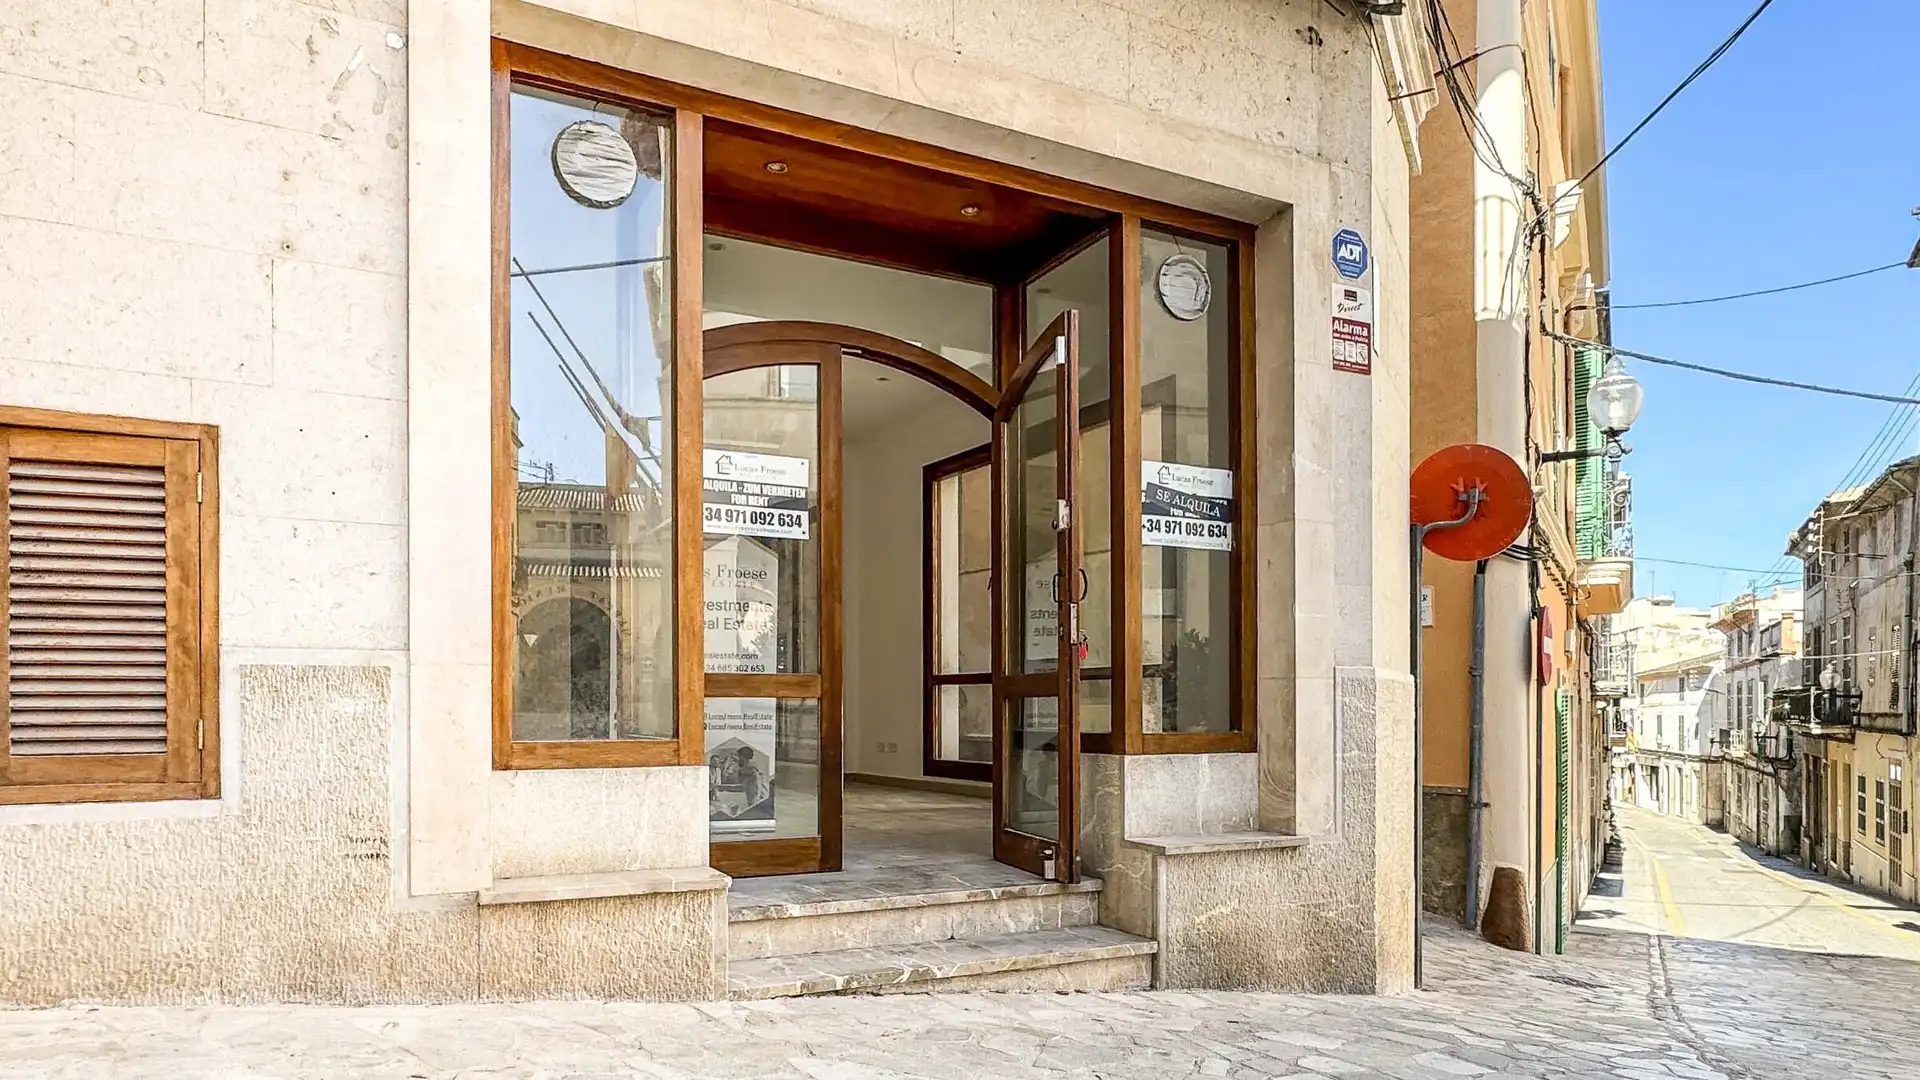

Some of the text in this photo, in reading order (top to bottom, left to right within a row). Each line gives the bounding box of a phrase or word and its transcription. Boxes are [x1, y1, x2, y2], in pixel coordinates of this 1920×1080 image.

[1338, 243, 1362, 262] ADT
[1333, 319, 1368, 337] Alarma
[1172, 473, 1191, 483] Lucas
[703, 479, 738, 492] ALQUILA
[742, 482, 761, 494] ZUM
[762, 484, 806, 498] VERMIETEN
[731, 493, 769, 507] FOR RENT
[1156, 489, 1171, 503] SE
[1172, 494, 1220, 517] ALQUILA
[704, 507, 802, 528] 34 971 092 634
[1142, 518, 1227, 538] +34 971 092 634
[717, 564, 768, 580] Froese
[703, 600, 773, 613] estments
[703, 617, 719, 630] eal
[750, 664, 765, 672] 653
